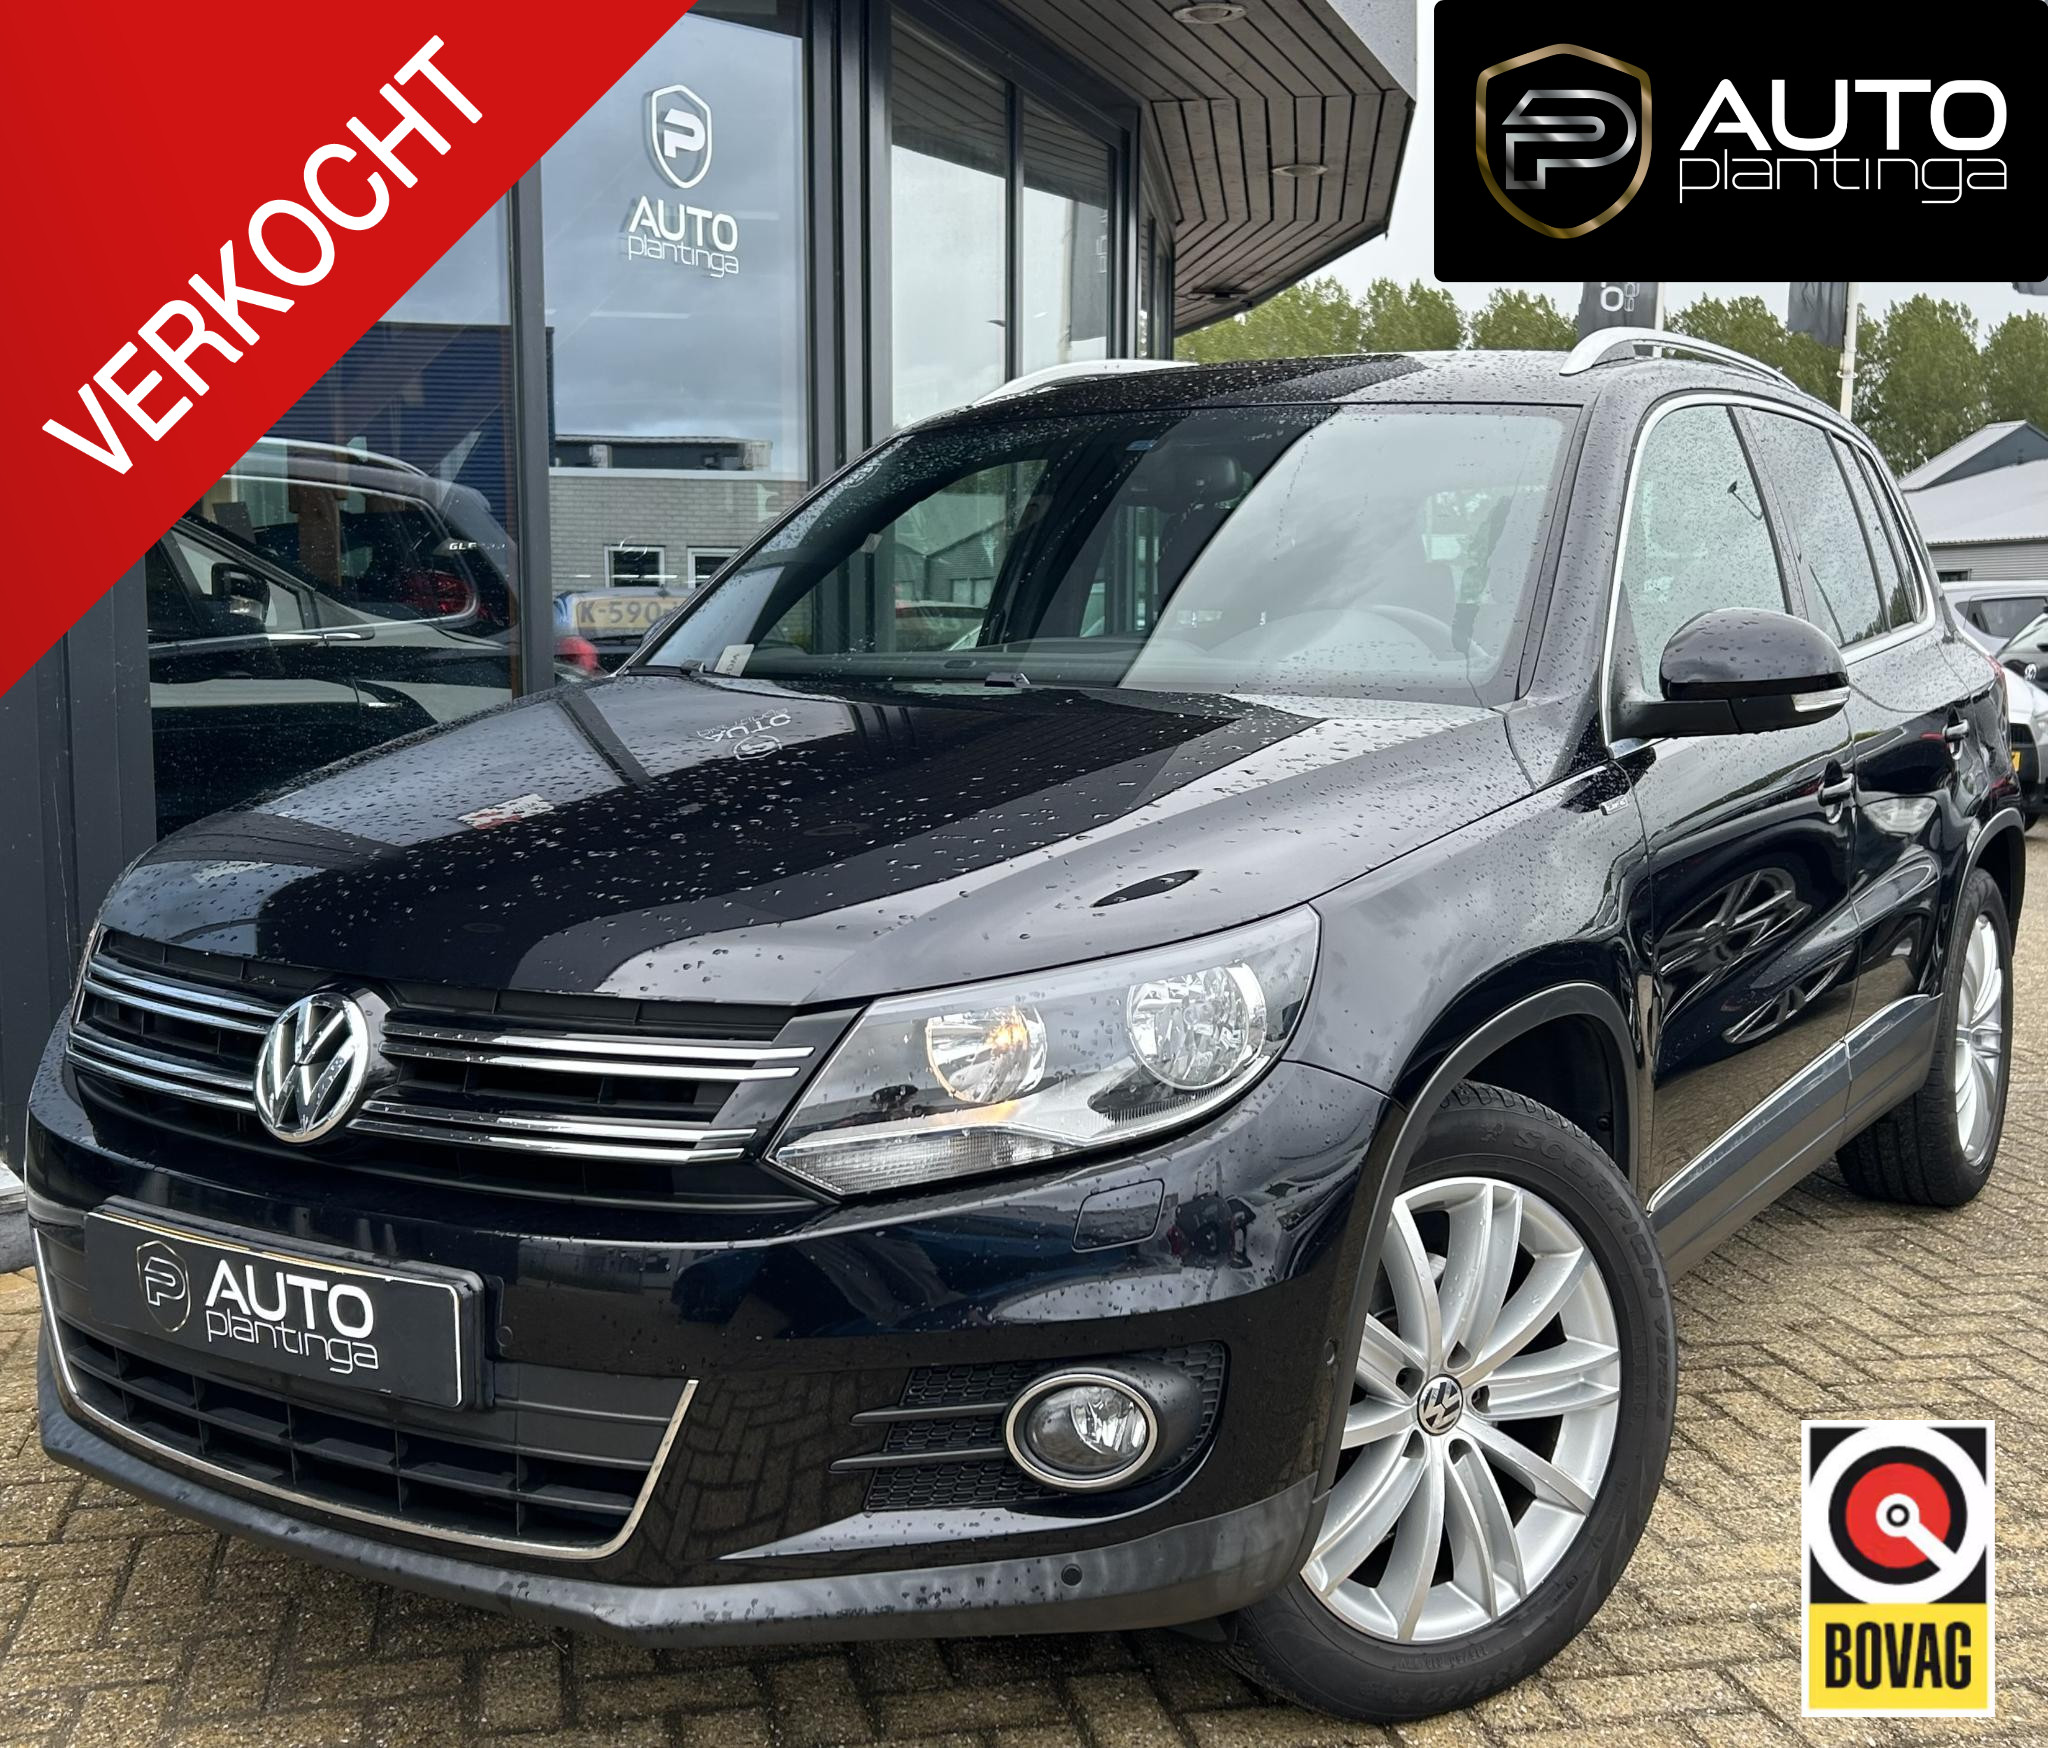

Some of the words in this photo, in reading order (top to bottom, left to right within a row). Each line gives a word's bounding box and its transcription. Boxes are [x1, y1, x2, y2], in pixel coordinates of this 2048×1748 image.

[628, 194, 738, 252] AUTO
[627, 233, 739, 279] plantinga
[204, 1258, 375, 1340] AUTO
[205, 1307, 380, 1375] plantinga
